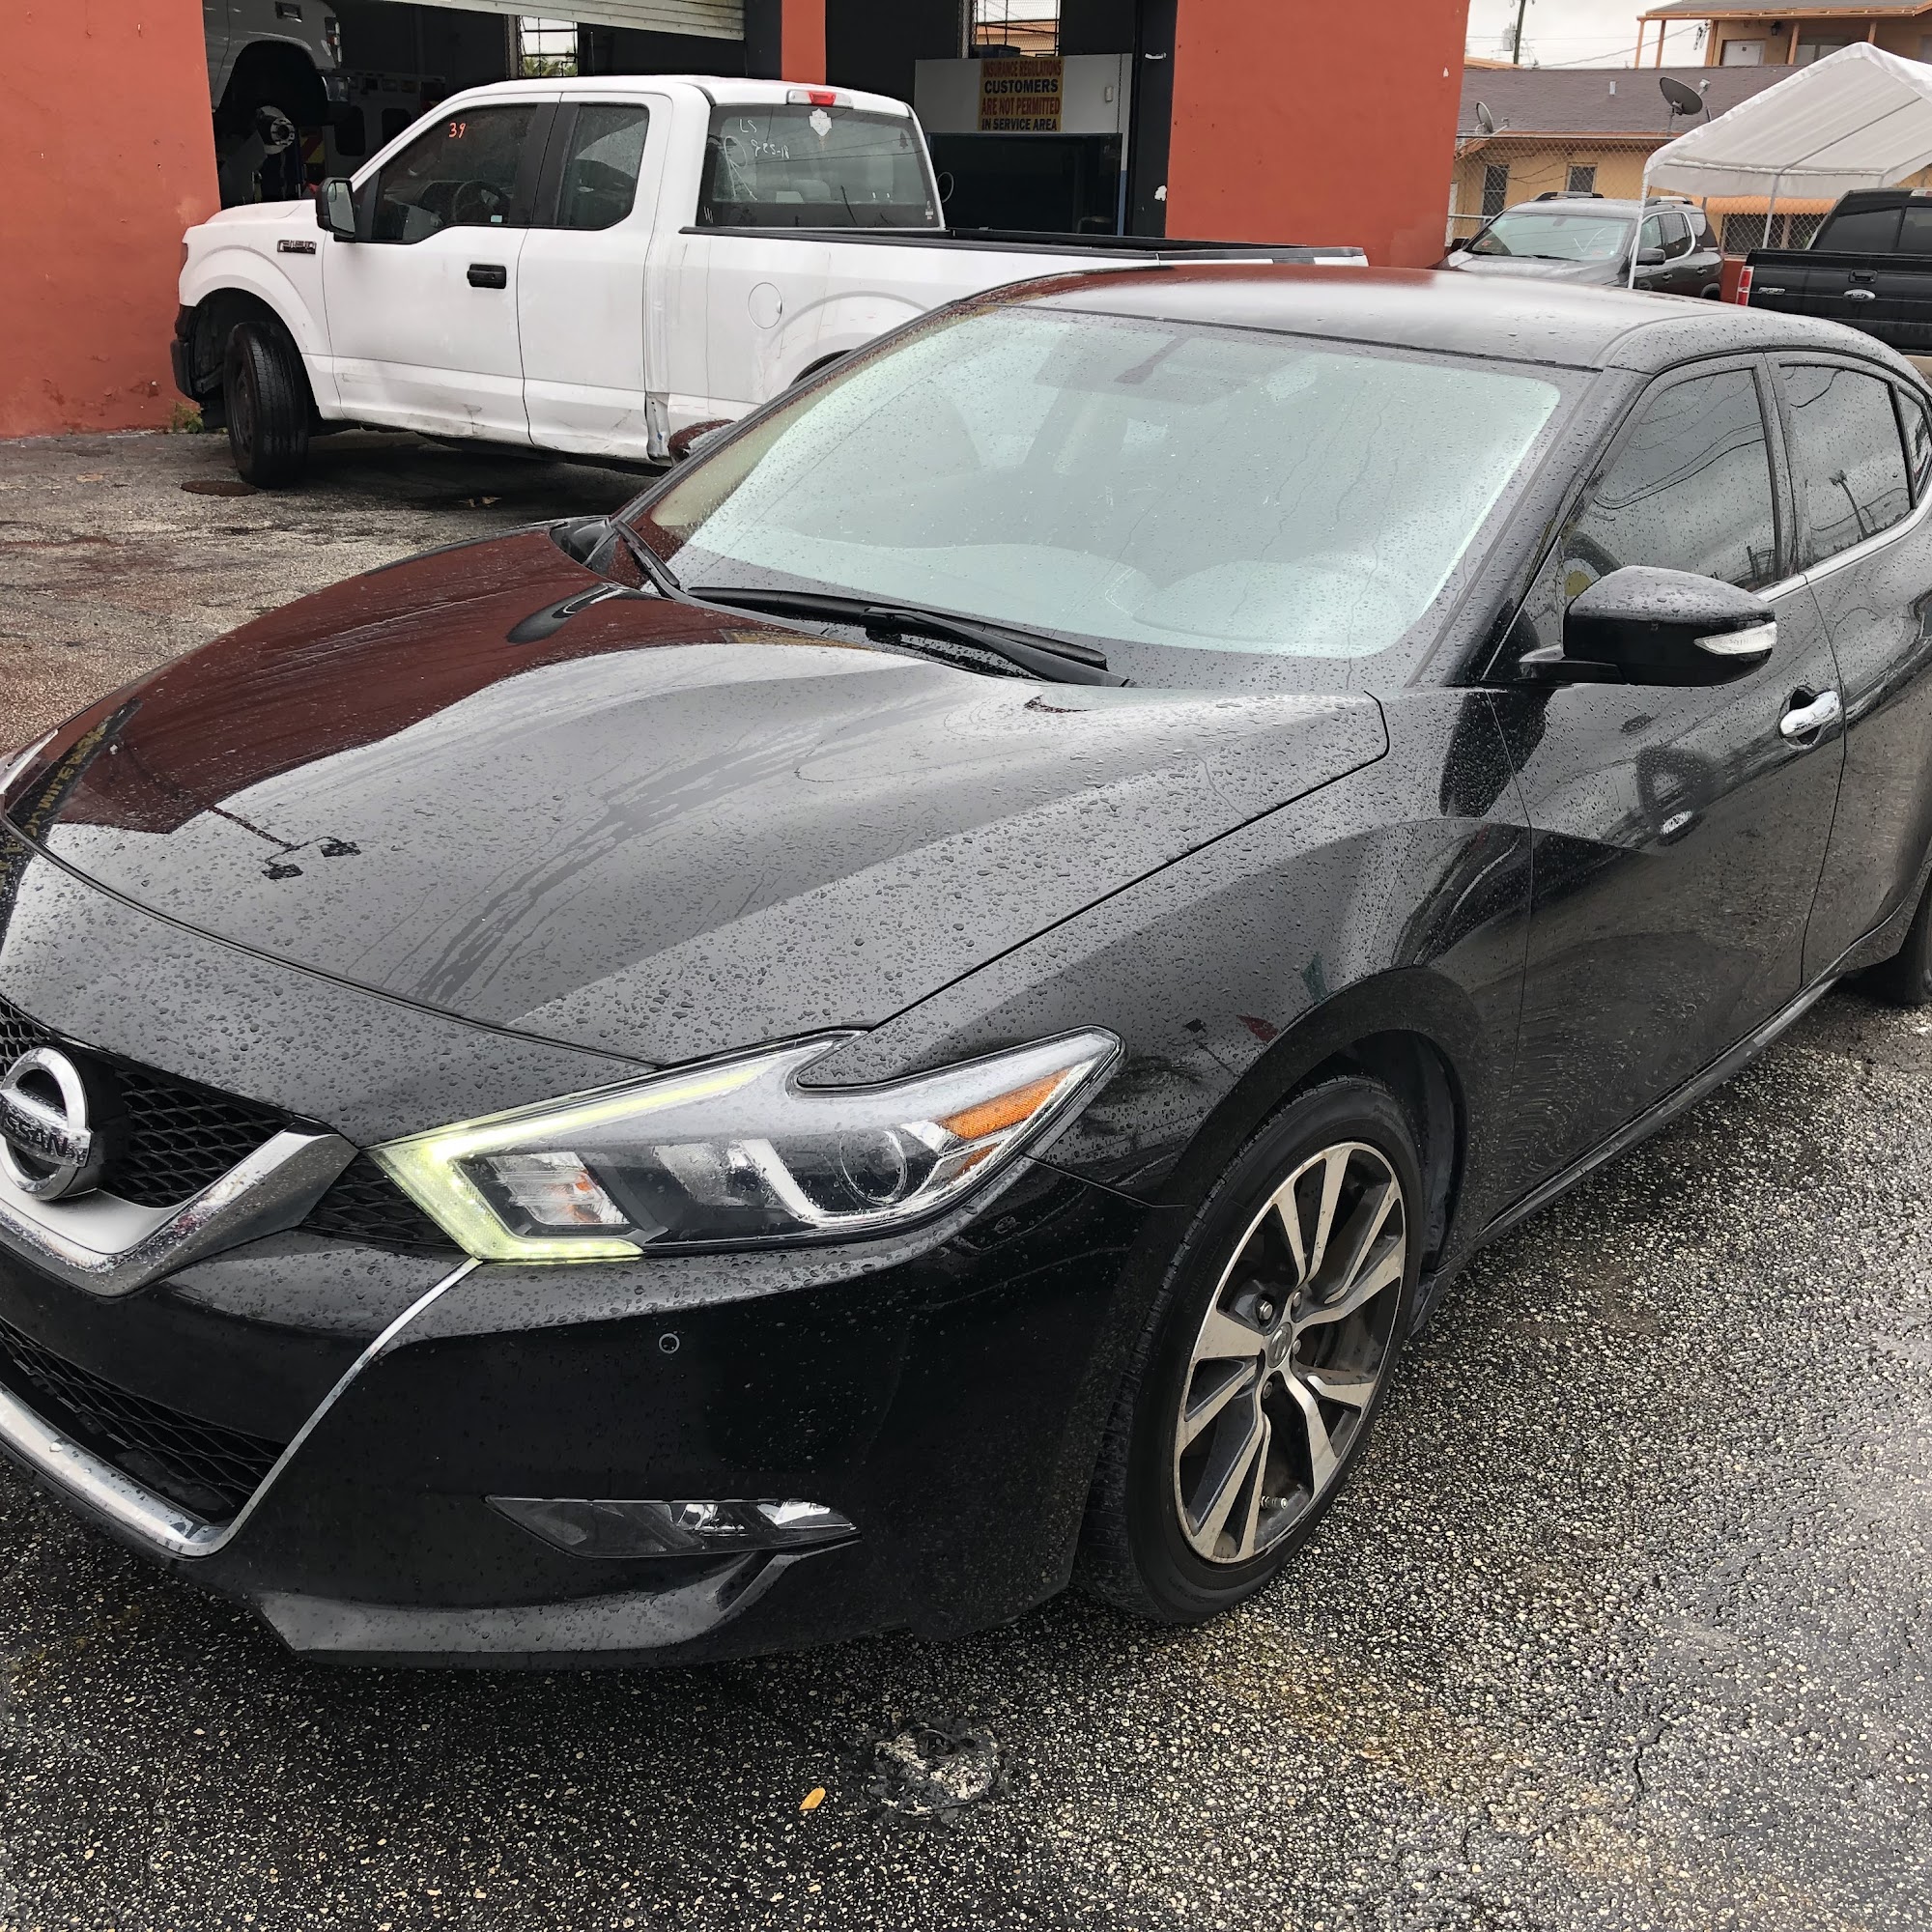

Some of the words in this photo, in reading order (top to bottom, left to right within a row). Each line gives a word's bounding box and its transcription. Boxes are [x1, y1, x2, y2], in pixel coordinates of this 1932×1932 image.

[983, 61, 1018, 77] INSURANCE
[1019, 60, 1062, 76] REGULATIONS
[984, 79, 1059, 94] CUSTOMERS
[981, 98, 998, 115] ARE
[999, 98, 1015, 115] NOT
[1016, 97, 1061, 114] PERMITTED
[448, 122, 467, 139] 39
[981, 118, 992, 130] IN
[993, 118, 1031, 130] SERVICE
[1033, 118, 1057, 130] AREA
